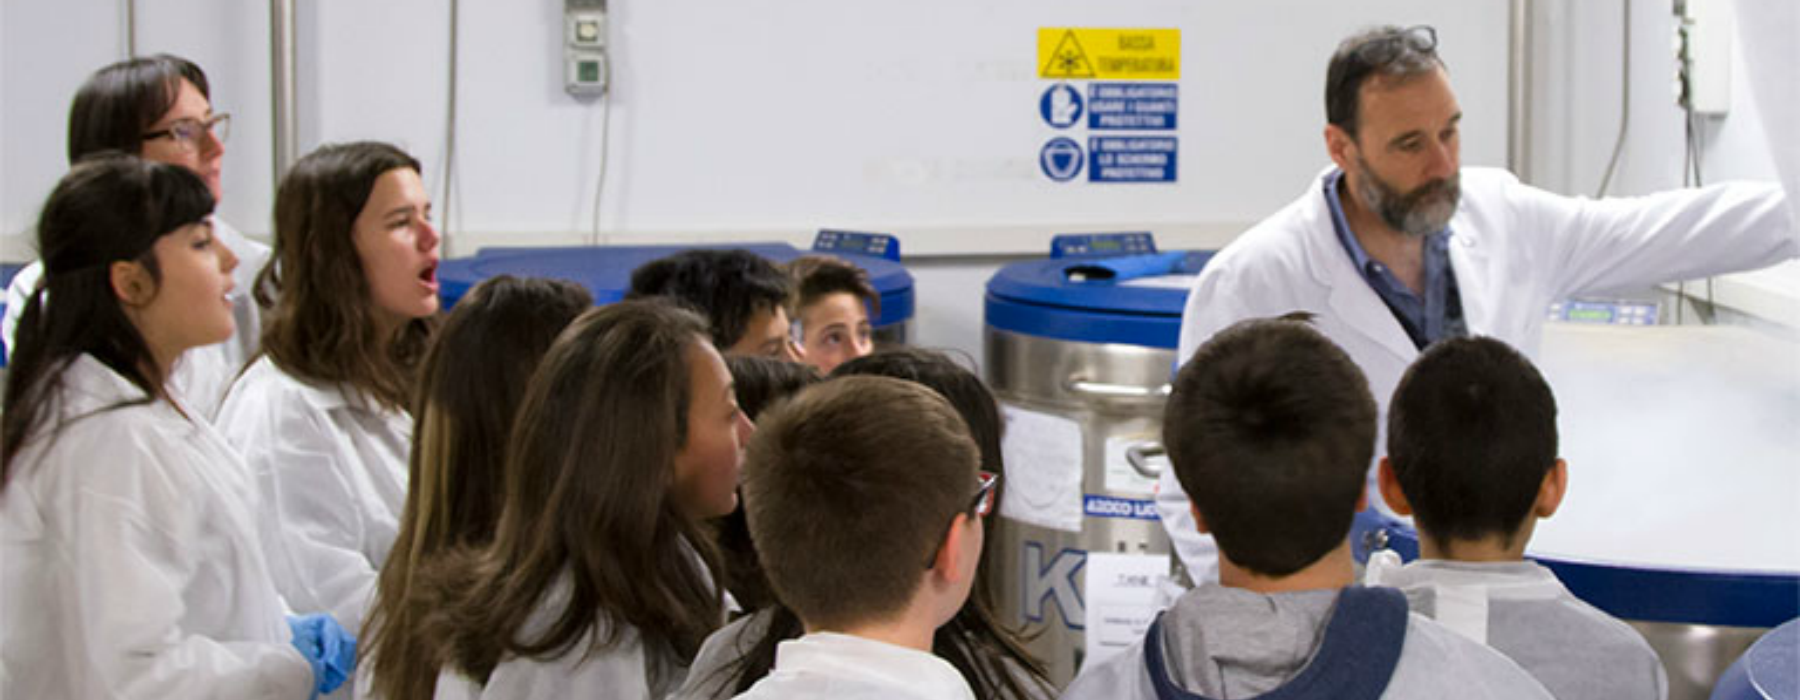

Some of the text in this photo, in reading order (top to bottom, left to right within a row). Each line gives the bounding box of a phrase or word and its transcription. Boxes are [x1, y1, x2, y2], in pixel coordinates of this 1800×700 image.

[1118, 35, 1155, 50] BASSA
[1098, 57, 1176, 72] TEMPERATURA
[1090, 101, 1124, 112] USARE
[1135, 101, 1176, 112] GUANTI
